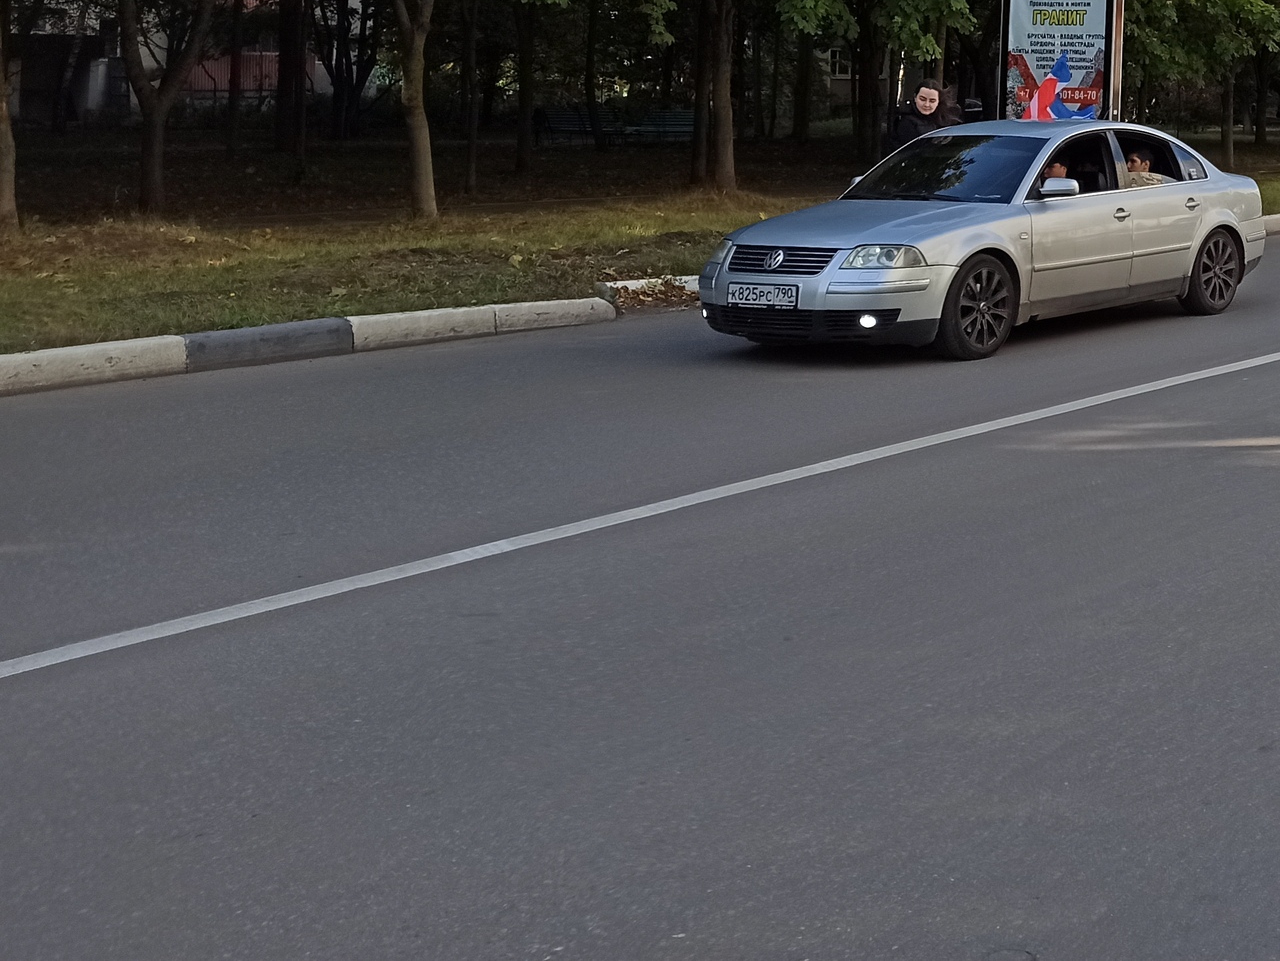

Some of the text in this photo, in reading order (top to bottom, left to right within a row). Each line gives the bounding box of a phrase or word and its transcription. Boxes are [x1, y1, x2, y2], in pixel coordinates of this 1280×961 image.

[1032, 9, 1088, 26] ГРАНИТ
[730, 286, 793, 302] К825РС 790
